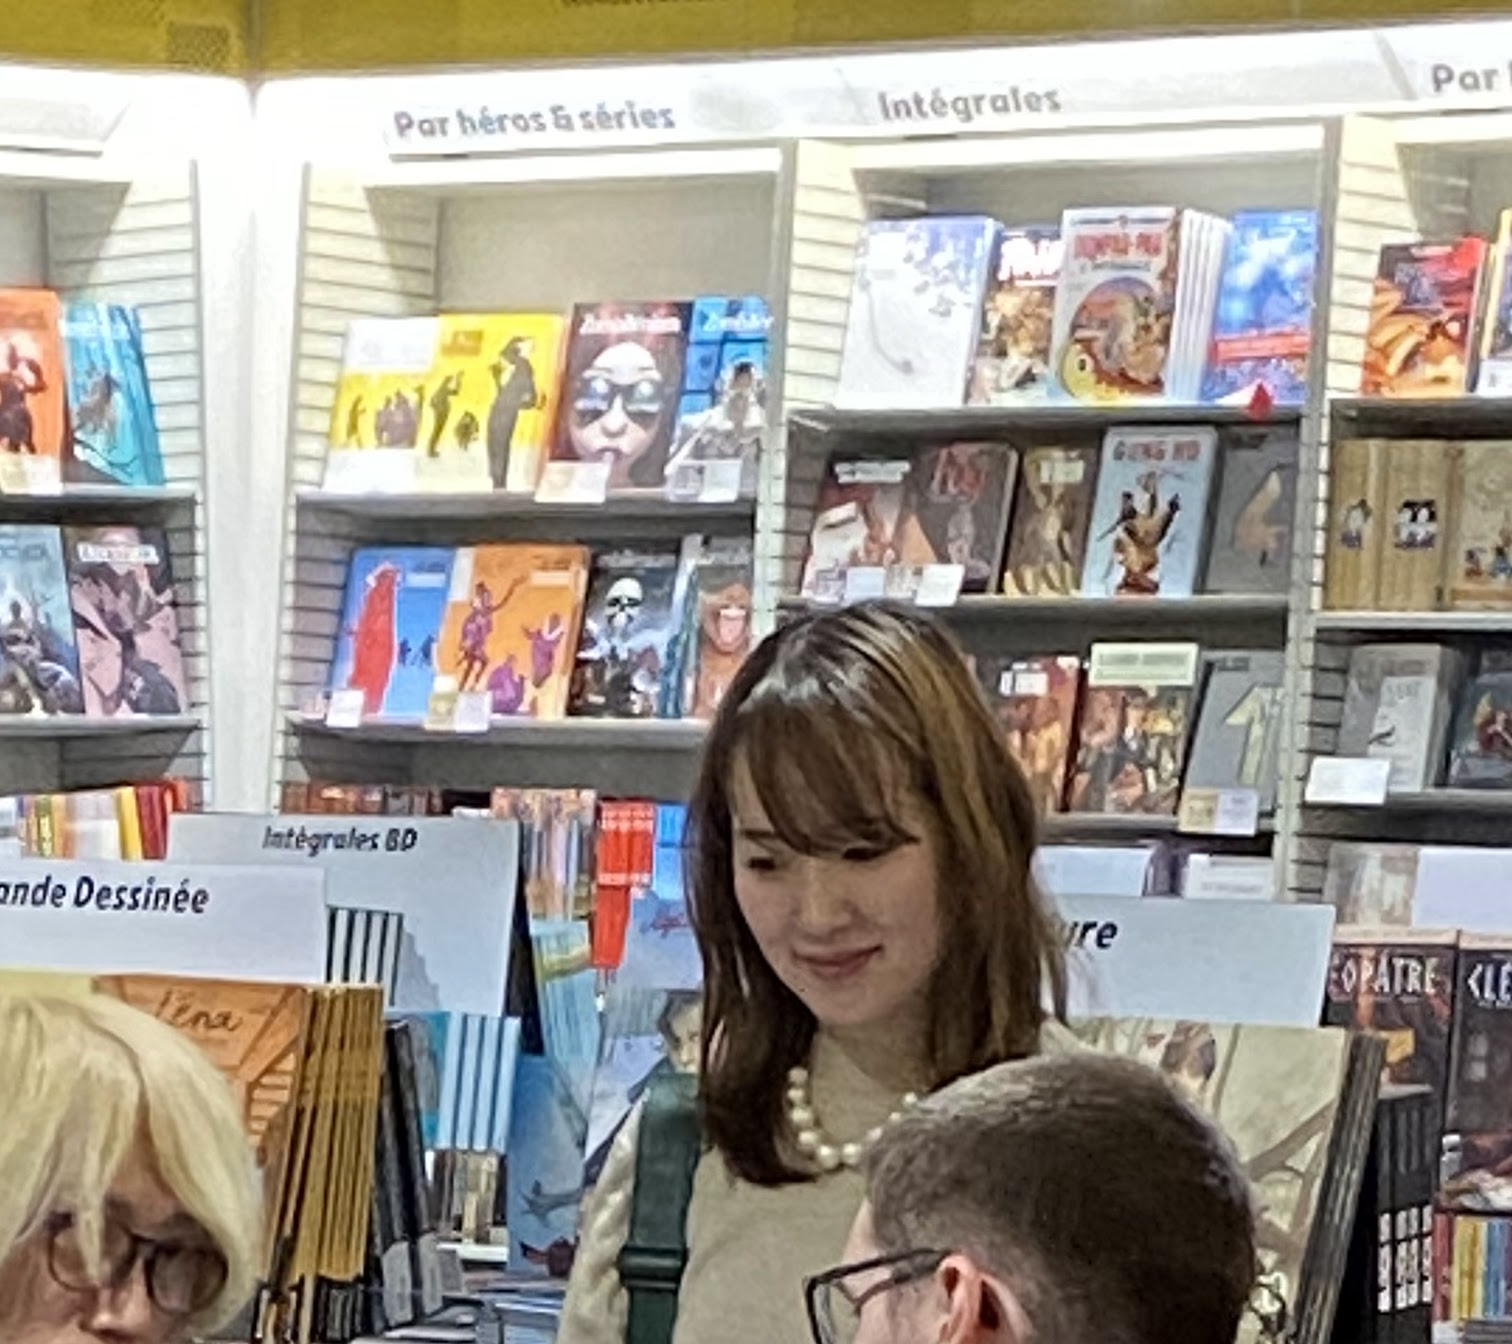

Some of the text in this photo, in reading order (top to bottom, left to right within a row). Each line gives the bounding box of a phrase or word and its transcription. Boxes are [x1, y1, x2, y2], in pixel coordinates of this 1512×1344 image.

[1432, 63, 1499, 93] Par
[394, 100, 676, 139] Par héros & séries
[877, 86, 1063, 123] Intégrales
[263, 826, 418, 857] Intégrales BD
[73, 873, 210, 914] Dessinée
